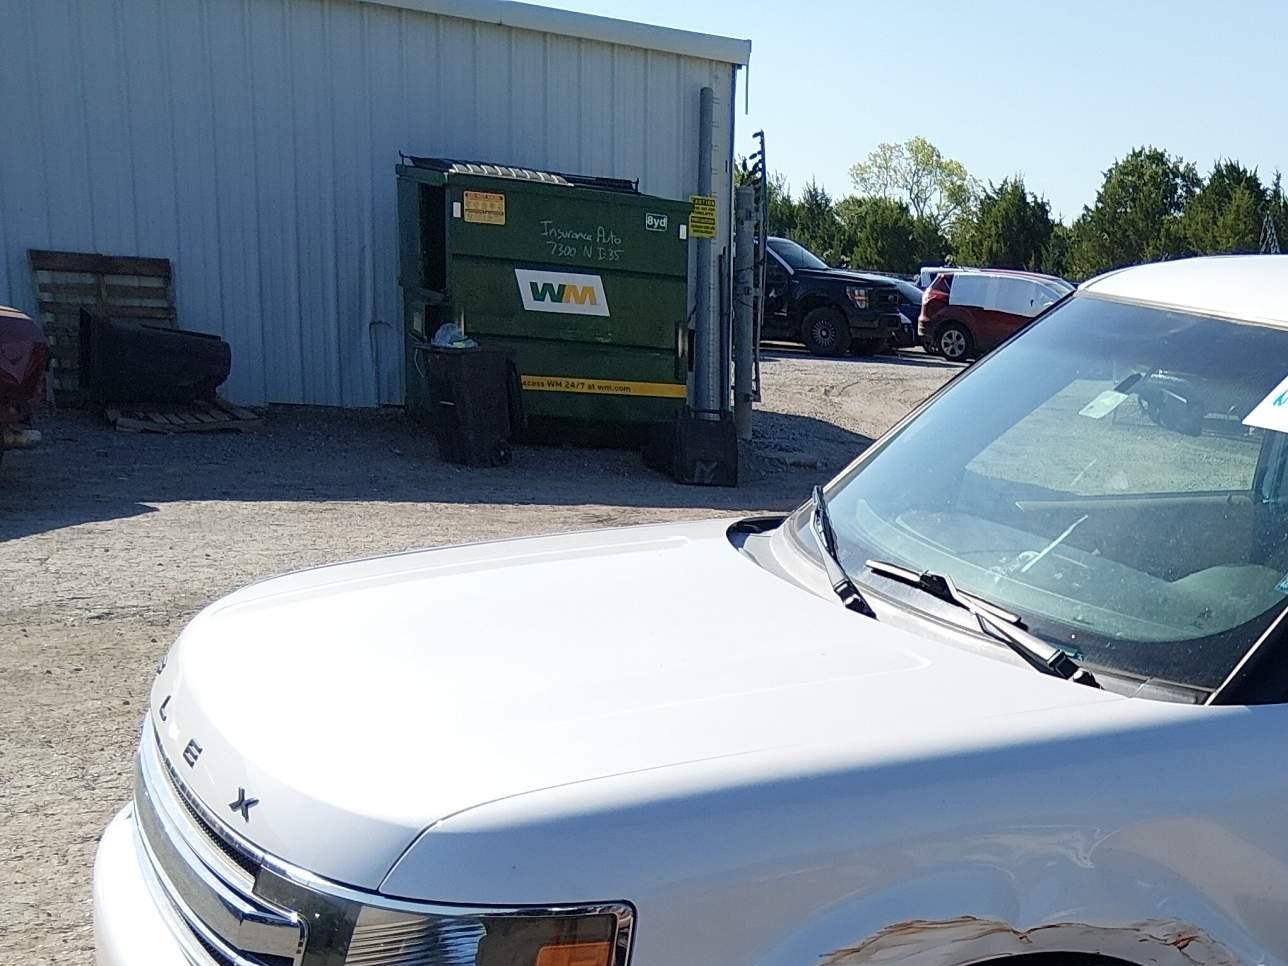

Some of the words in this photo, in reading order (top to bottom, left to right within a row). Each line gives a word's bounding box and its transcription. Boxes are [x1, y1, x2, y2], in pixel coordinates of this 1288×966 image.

[647, 215, 667, 228] 8yd
[540, 221, 592, 241] Insurance
[597, 226, 621, 245] Auto
[546, 241, 577, 257] 7300
[583, 245, 593, 258] N
[529, 281, 597, 305] WM
[547, 381, 562, 389] WM
[565, 381, 584, 390] 24/7
